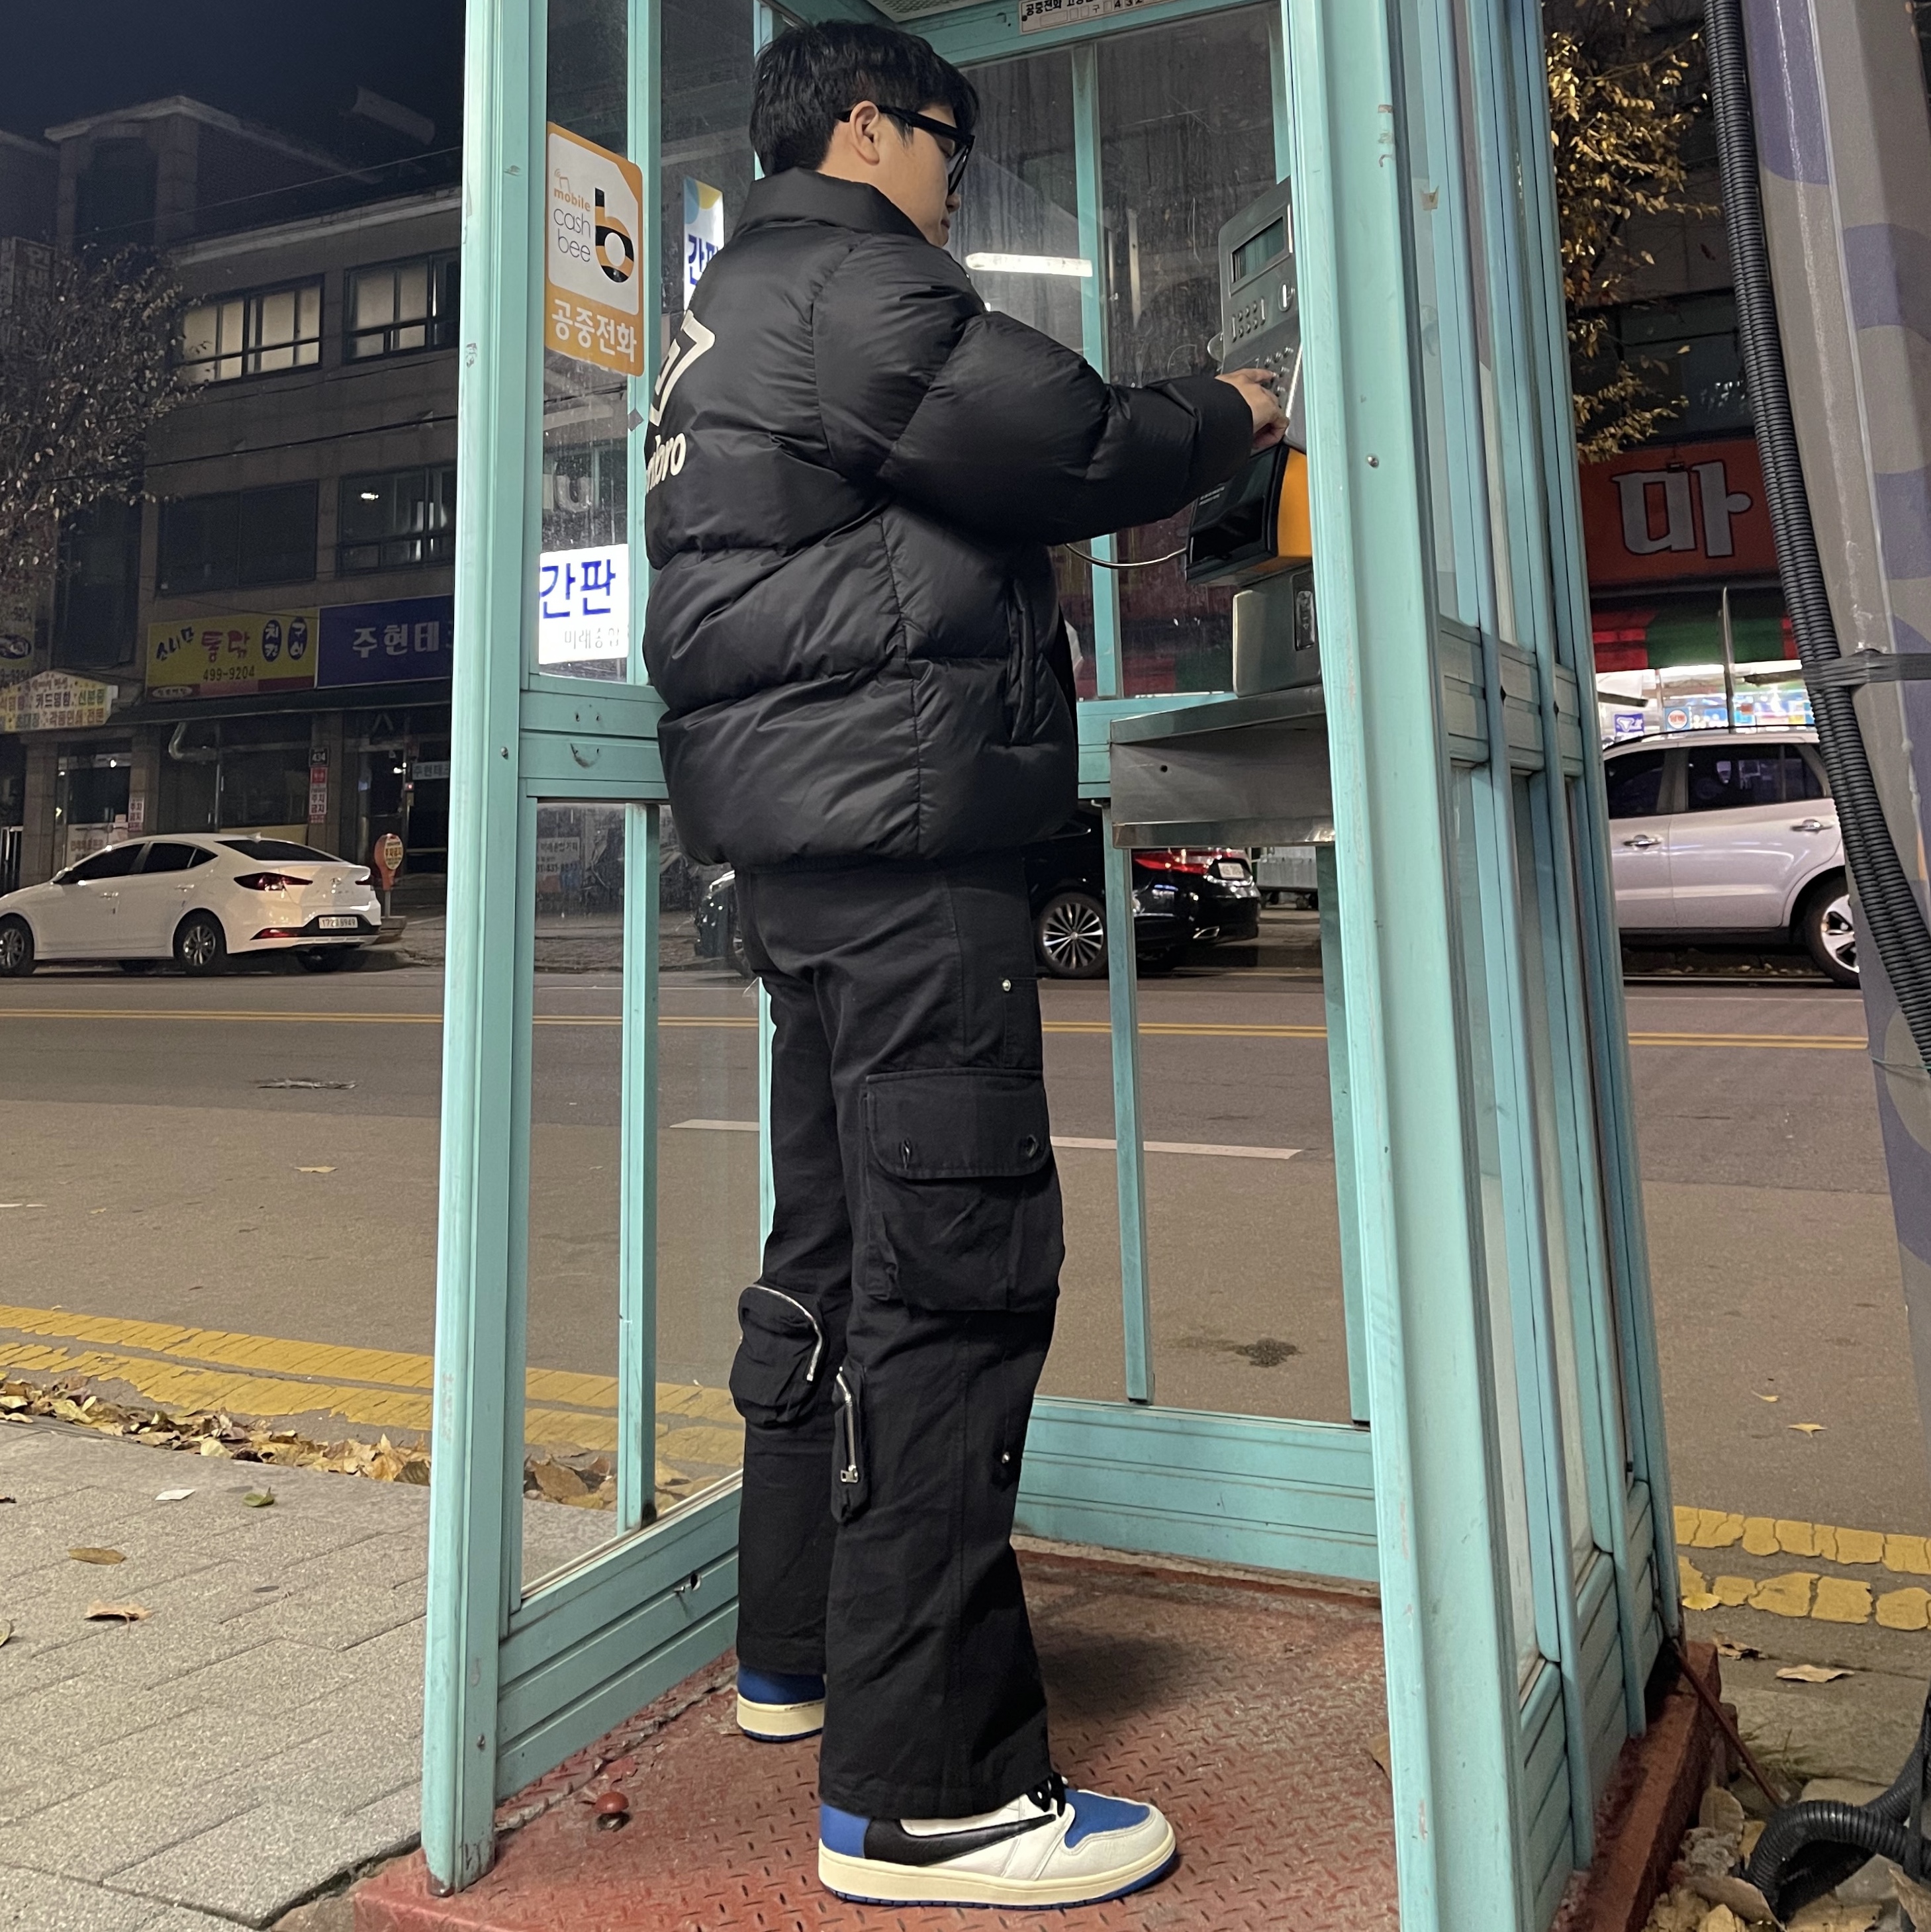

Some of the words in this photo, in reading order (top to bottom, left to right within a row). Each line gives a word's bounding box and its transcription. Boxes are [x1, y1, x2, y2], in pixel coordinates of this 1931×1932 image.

[1026, 0, 1062, 16] 공중전화
[553, 187, 591, 212] mobile
[553, 208, 591, 239] cash
[557, 228, 591, 263] bee
[552, 298, 637, 363] 공중전화
[540, 558, 616, 620] 간판
[352, 621, 452, 659] 주현테
[203, 666, 256, 682] 499-9204
[312, 752, 326, 762] 434
[322, 918, 339, 927] 172
